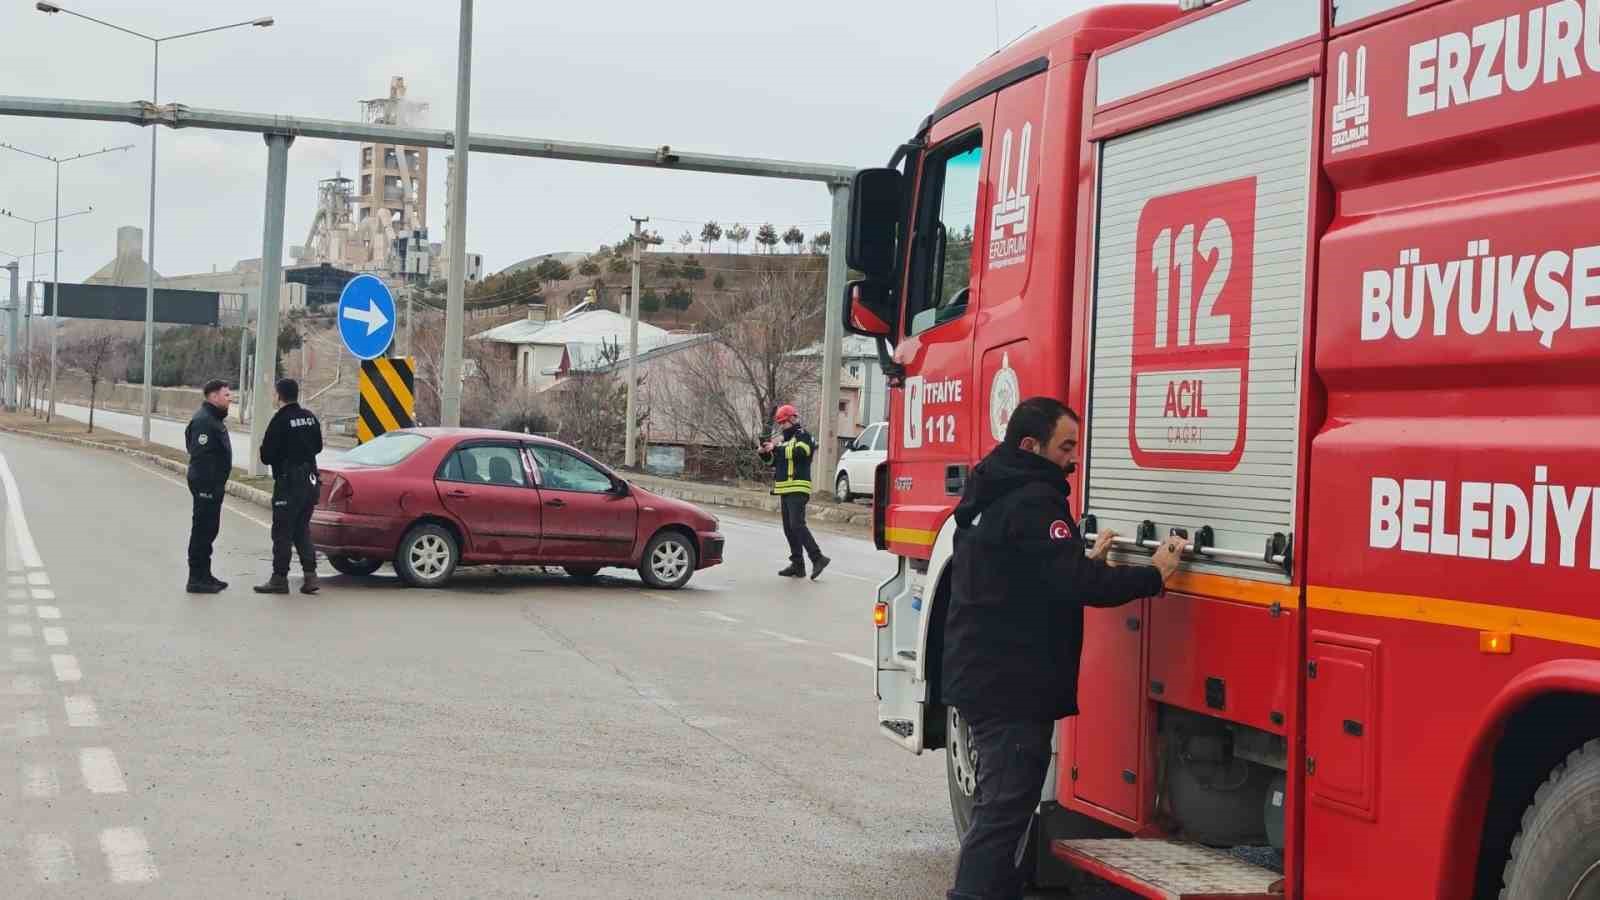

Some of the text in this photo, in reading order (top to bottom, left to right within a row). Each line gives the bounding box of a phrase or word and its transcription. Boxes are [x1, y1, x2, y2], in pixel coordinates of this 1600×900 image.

[988, 236, 1026, 259] ERZURUM
[1152, 218, 1232, 348] 112
[923, 376, 962, 405] İTFAİYE
[925, 414, 956, 443] 112
